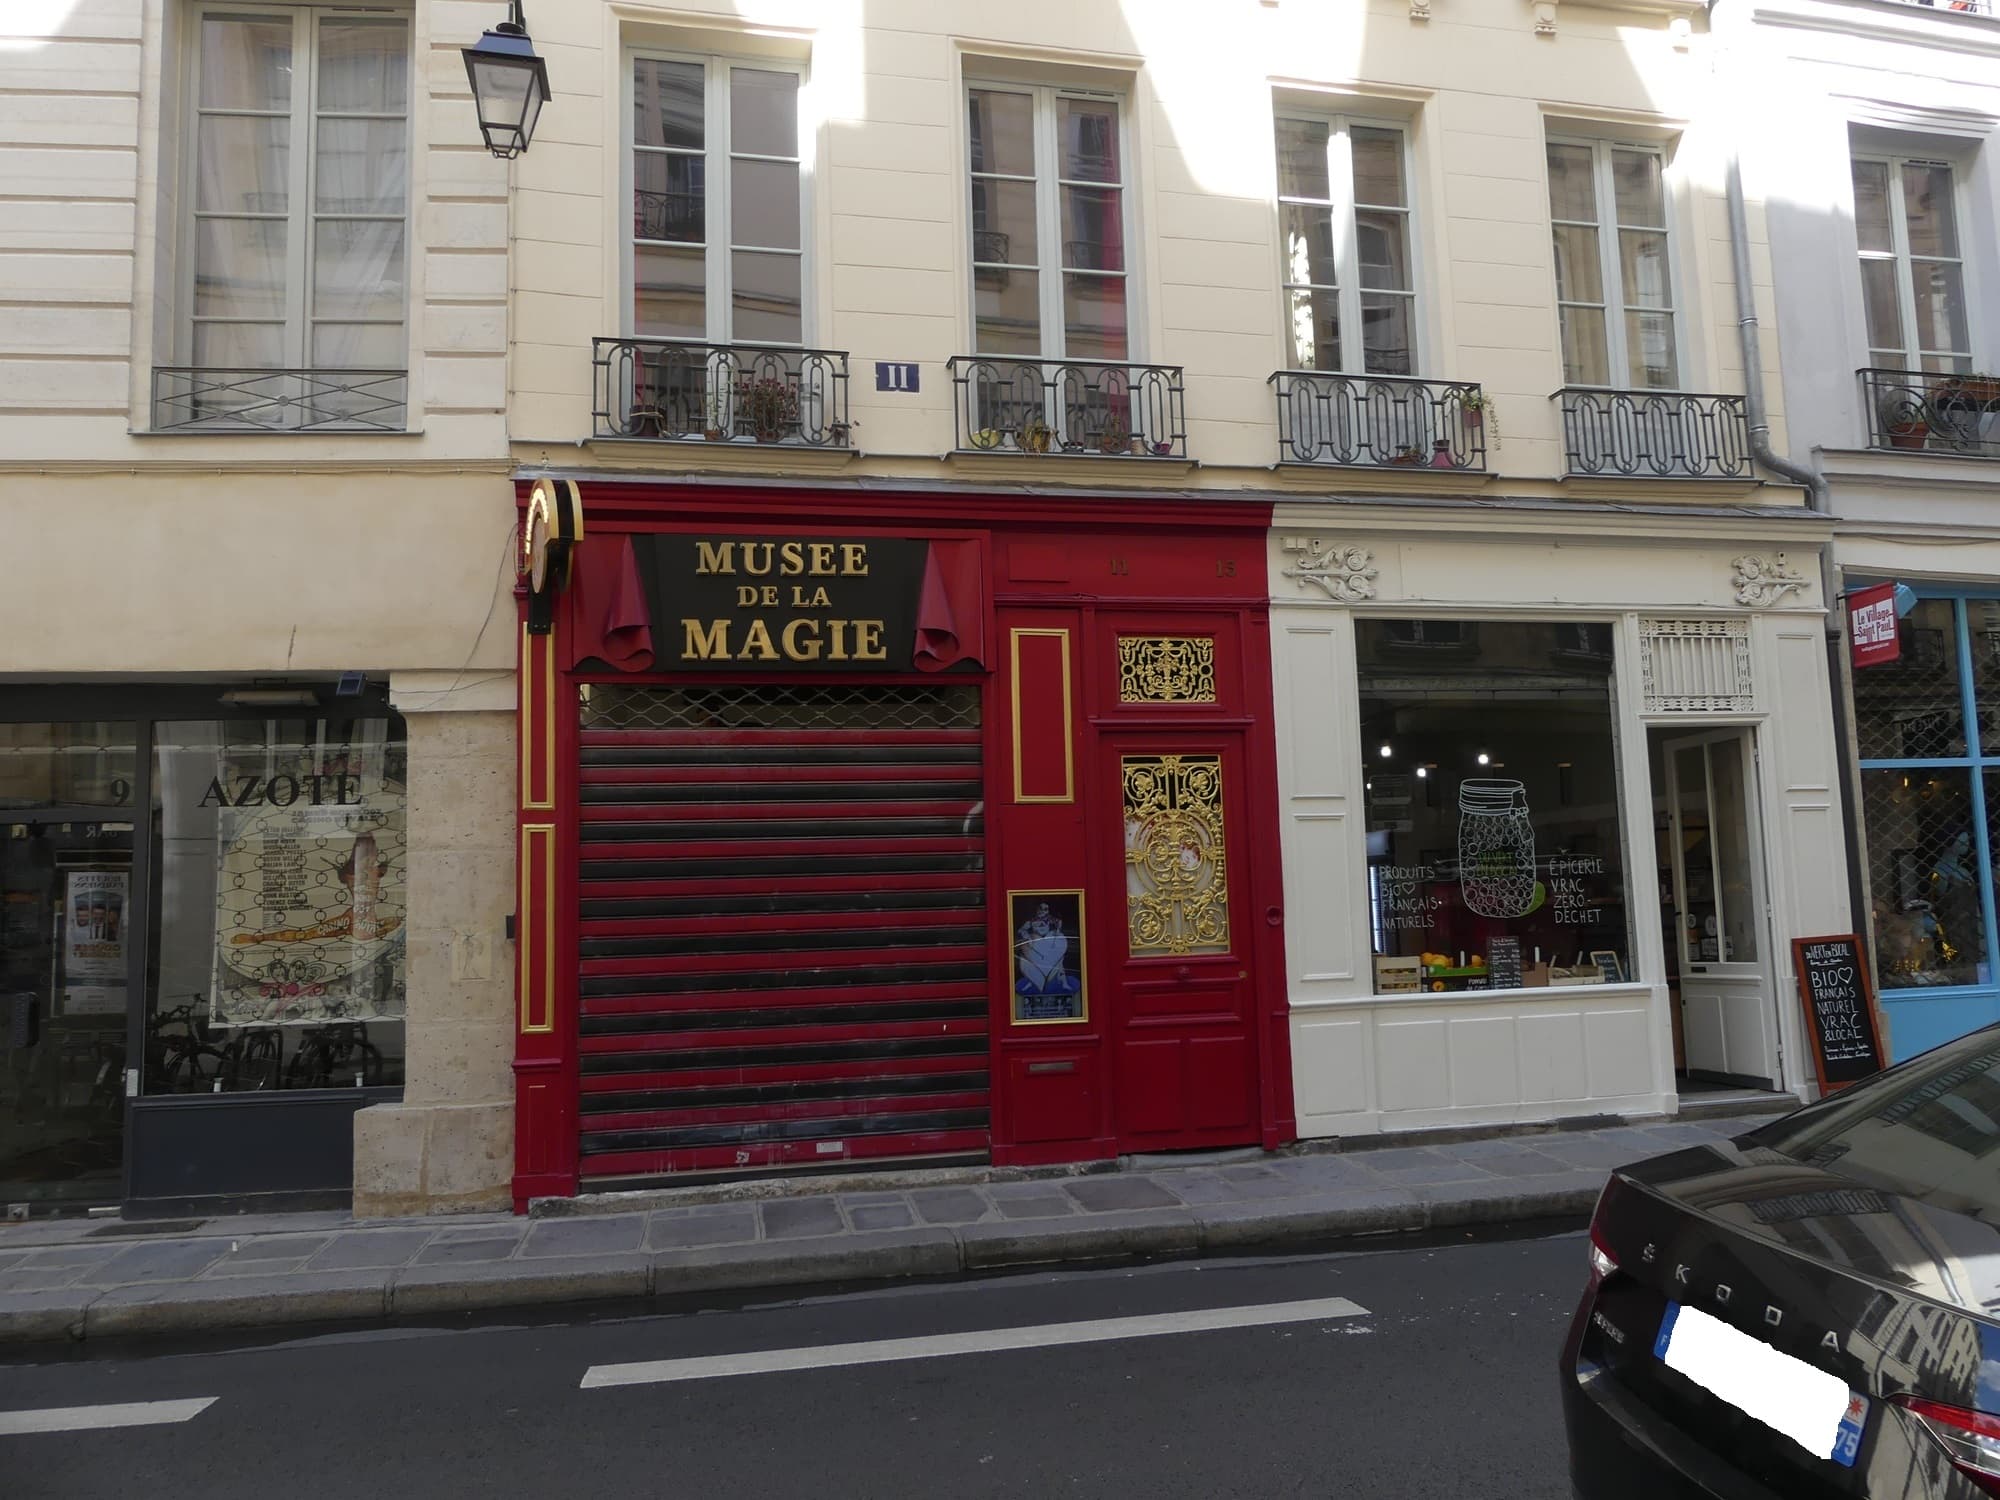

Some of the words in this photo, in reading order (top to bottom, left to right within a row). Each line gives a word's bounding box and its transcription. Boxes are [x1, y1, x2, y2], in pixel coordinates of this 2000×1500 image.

[695, 542, 869, 576] MUSEE
[1110, 559, 1128, 576] 11
[736, 586, 779, 607] DE
[792, 586, 832, 607] LA
[1857, 610, 1865, 625] Le
[1866, 601, 1889, 623] Village
[681, 618, 887, 661] MAGIE
[1858, 625, 1875, 642] Saint
[1876, 618, 1891, 640] Paul
[111, 779, 130, 806] 9
[197, 775, 363, 807] AZOTE
[1550, 878, 1585, 893] VRAC
[1382, 896, 1438, 913] FRANÇAIS
[1382, 914, 1435, 929] NATURELS
[1814, 986, 1856, 1001] FRANÇAIS
[1817, 1000, 1859, 1015] NATUREL
[1820, 1013, 1861, 1030] VRAC
[1834, 1427, 1861, 1458] 75
